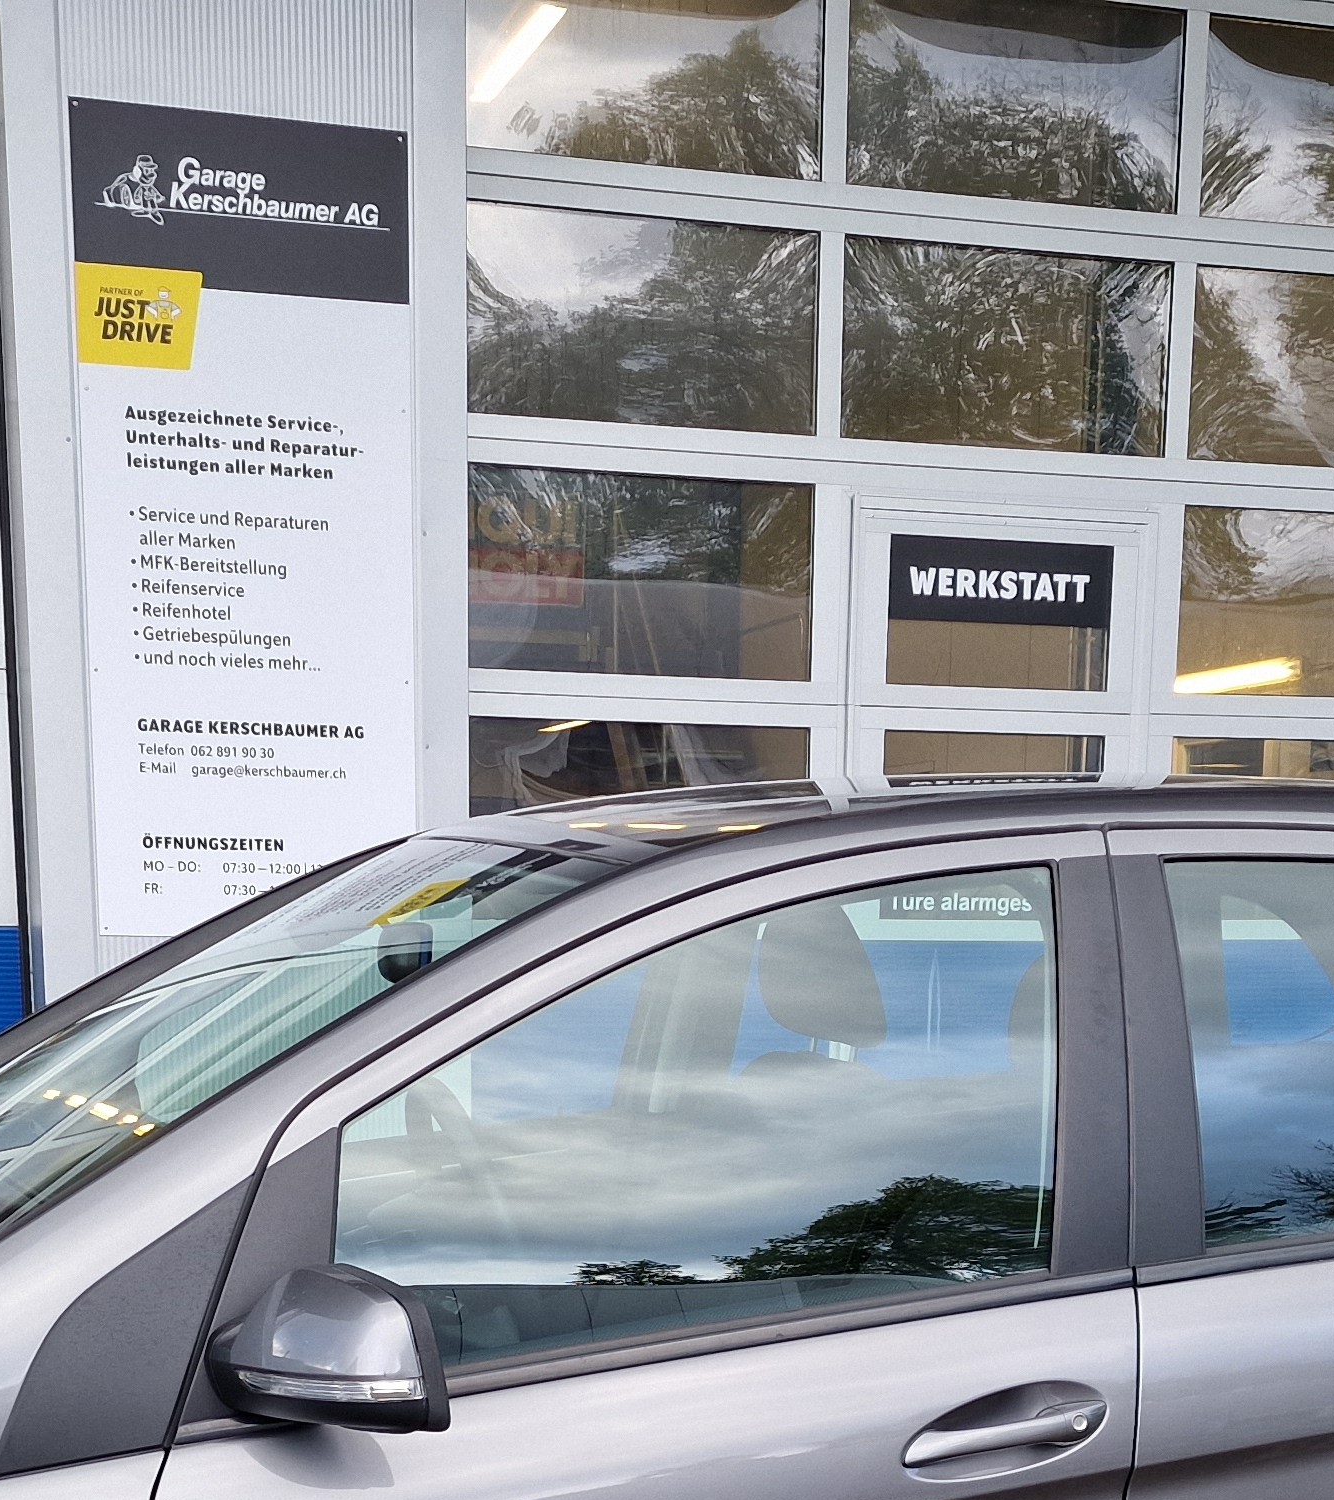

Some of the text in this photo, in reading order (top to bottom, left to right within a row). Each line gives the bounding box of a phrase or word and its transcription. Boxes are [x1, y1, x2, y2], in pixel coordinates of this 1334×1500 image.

[177, 156, 266, 194] Garage
[169, 181, 379, 226] Kerschbaumer AG
[99, 286, 144, 297] PARTNER OF
[94, 296, 150, 320] JUST
[101, 319, 174, 345] DRIVE
[125, 405, 344, 436] Ausgezeichnete Service-,
[125, 429, 364, 458] Unterhalts- und Reparatur-
[126, 452, 334, 480] leistungen aller Marken
[138, 505, 329, 532] Service und Reparaturen
[139, 529, 236, 550] aller Marken
[140, 554, 288, 580] MFK-Bereitstellung
[141, 578, 245, 598] Reifenservice
[909, 565, 1091, 603] WERKSTATT
[142, 602, 231, 621] Reifenhotel
[143, 626, 292, 650] Getriebespülungen
[143, 650, 321, 672] und noch vieles mehr...
[137, 718, 364, 739] GARAGE KERSCHBAUMER AG
[138, 743, 275, 759] Telefon 062 891 90 30
[139, 761, 346, 780] E-Mail garage@kerschbaumer.ch
[142, 833, 284, 852] ÖFFNUNGSZEITEN
[143, 860, 164, 872] MO
[177, 861, 201, 873] DO:
[222, 862, 256, 874] 07:30
[269, 863, 301, 874] 12:00
[144, 883, 163, 894] FR:
[223, 885, 256, 896] 07:30
